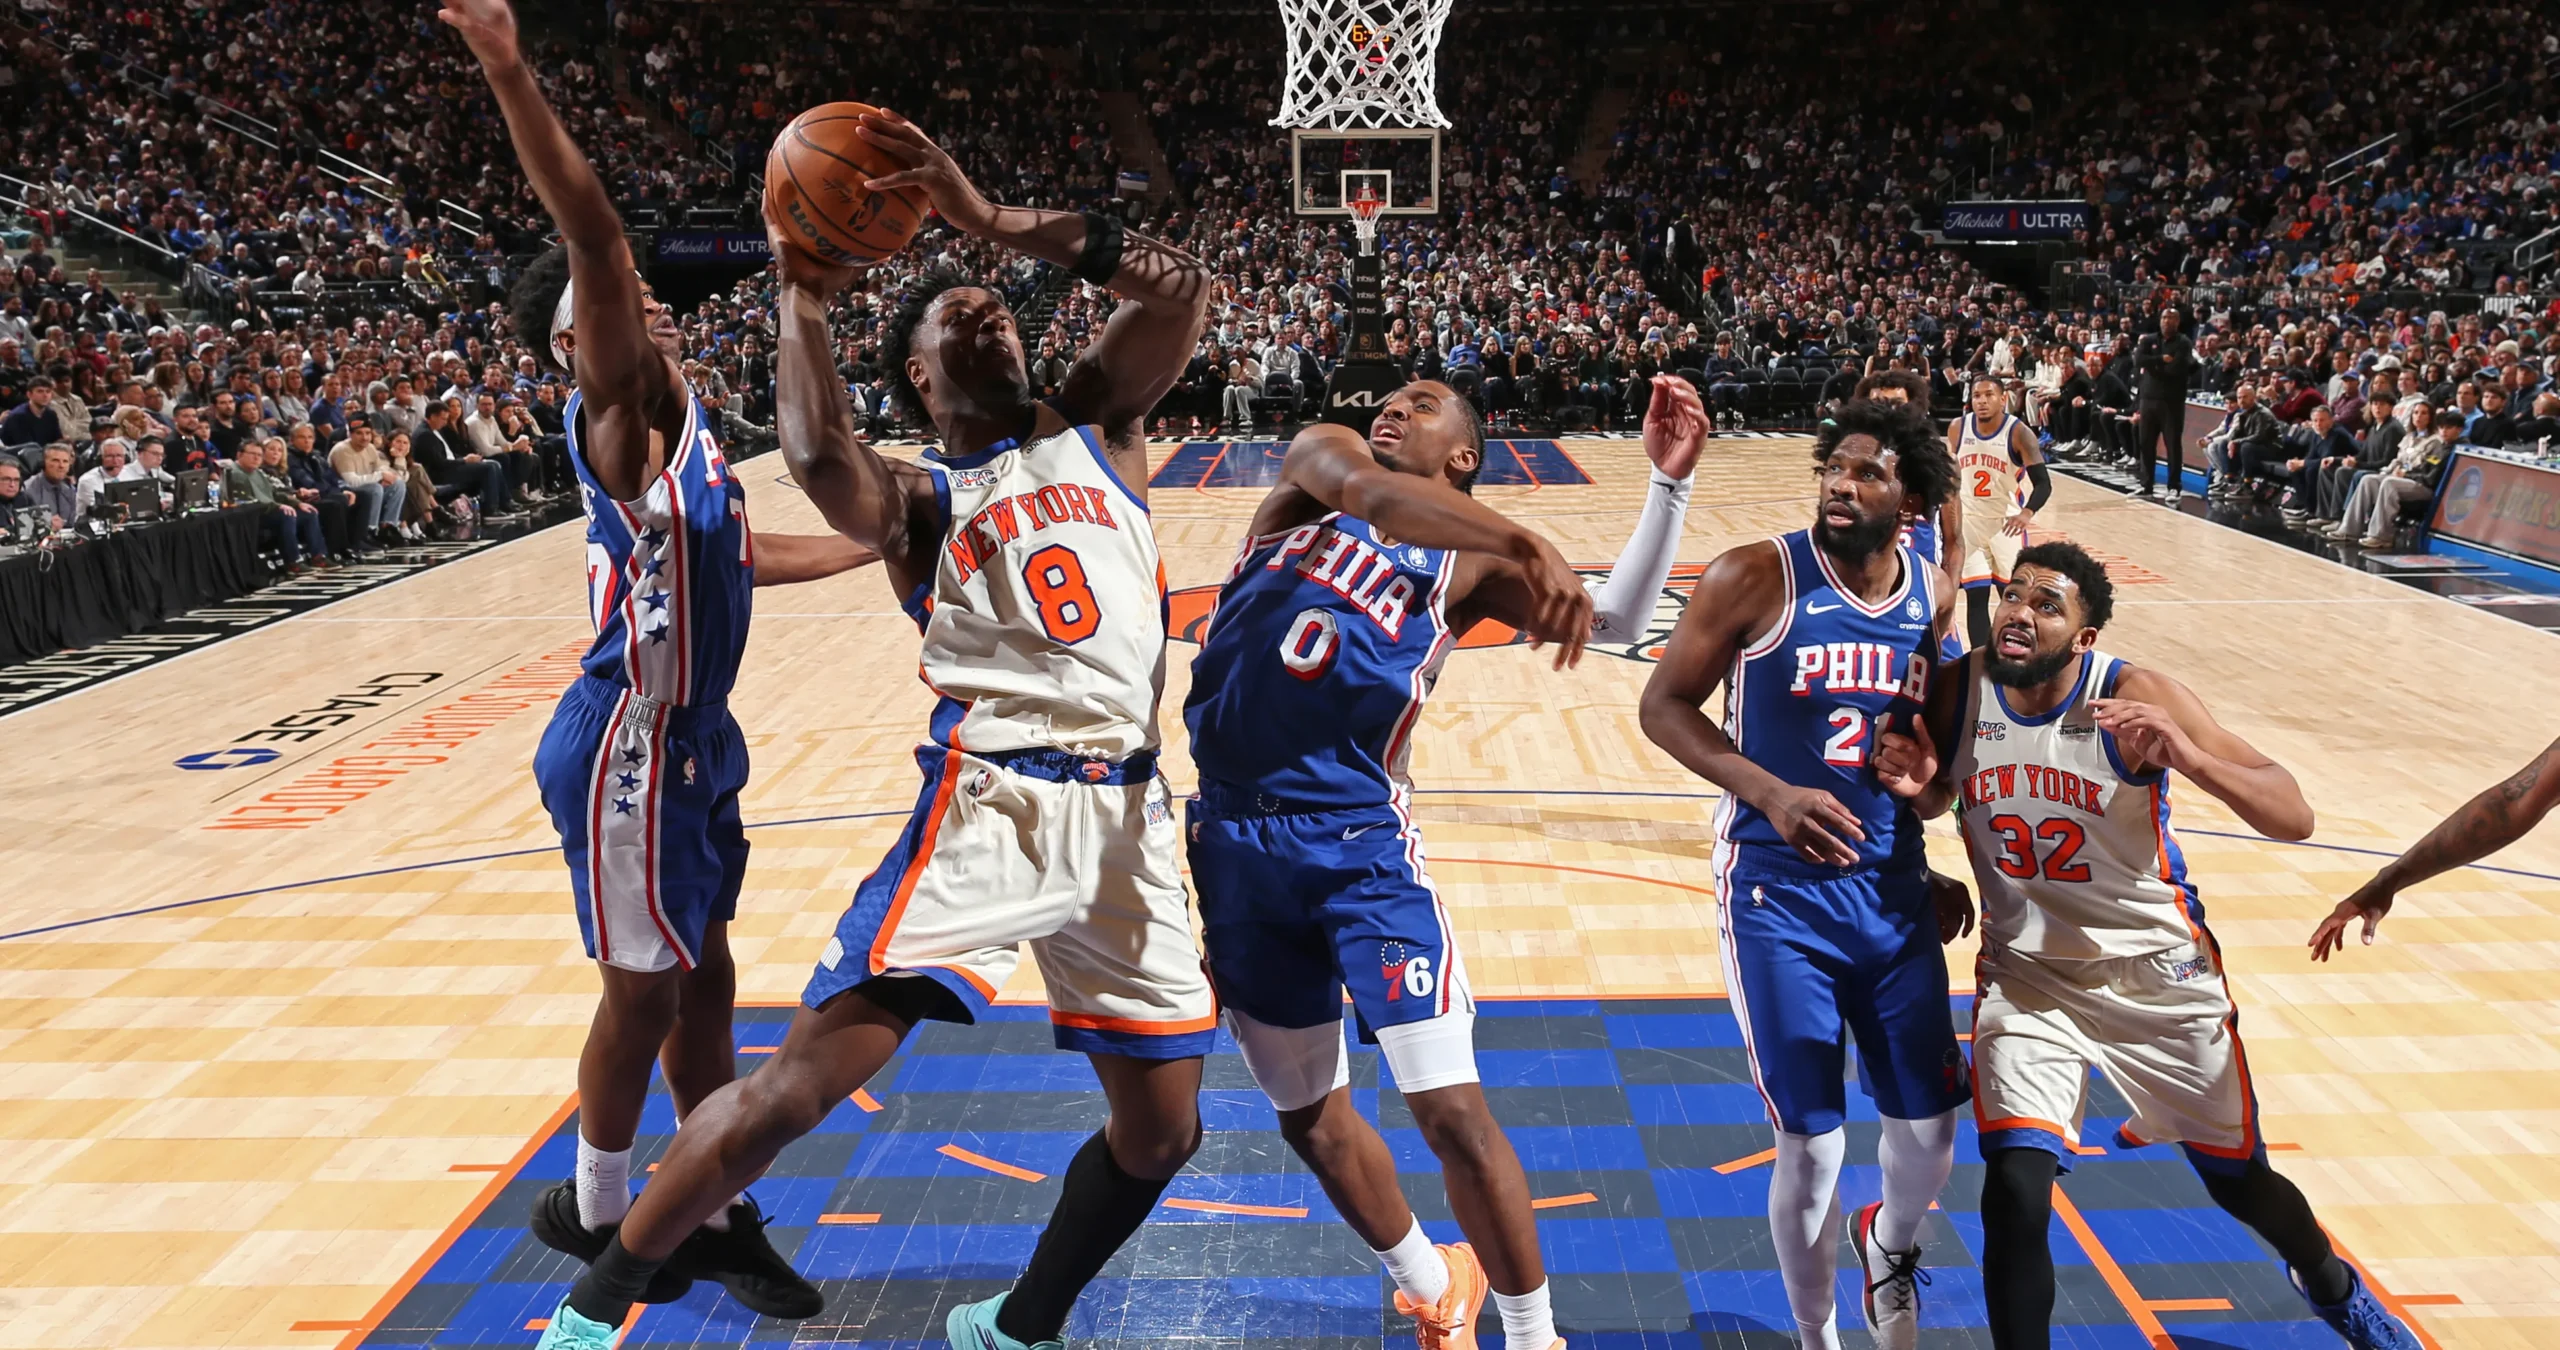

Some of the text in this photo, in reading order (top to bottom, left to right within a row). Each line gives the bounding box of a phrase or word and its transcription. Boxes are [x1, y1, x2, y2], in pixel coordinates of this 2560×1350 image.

[728, 241, 771, 253] ULTR
[1944, 211, 2085, 229] Michelob ULTRA
[952, 468, 998, 488] NYC
[1959, 453, 2008, 474] NEW YORK
[1973, 470, 1991, 497] 2
[948, 483, 1119, 587] NEW YORK
[1021, 543, 1103, 646] 8
[1266, 524, 1416, 644] PHILA
[1279, 607, 1341, 681] 0
[1790, 642, 1931, 704] PHILA
[230, 672, 445, 743] CHASE
[362, 693, 560, 750] SQUARE
[1972, 720, 2006, 741] NYC
[201, 755, 449, 830] GARDEN
[1961, 764, 2105, 817] NEW YORK
[1988, 814, 2092, 882] 32
[1382, 956, 1434, 1003] 76
[2173, 956, 2208, 982] NYC
